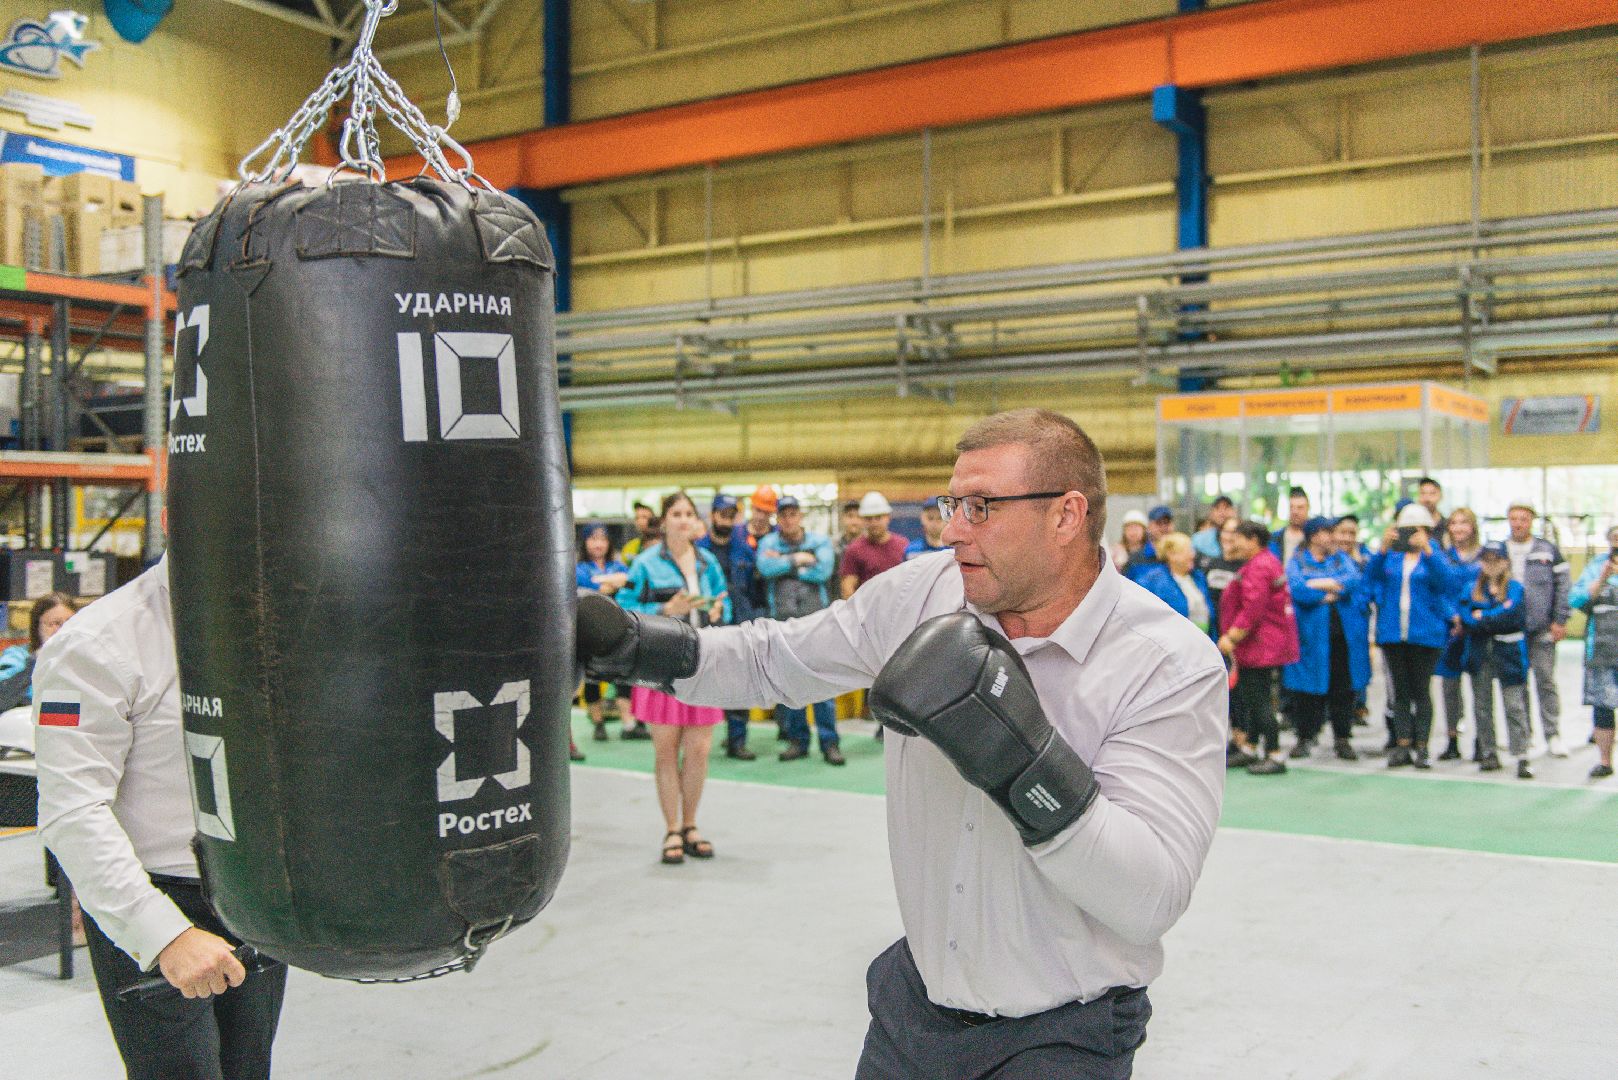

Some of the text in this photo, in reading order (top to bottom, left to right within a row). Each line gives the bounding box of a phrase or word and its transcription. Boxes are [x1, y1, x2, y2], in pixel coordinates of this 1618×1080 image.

[394, 293, 512, 317] УДАРНАЯ
[397, 332, 521, 442] 10
[438, 802, 533, 837] Ростех
